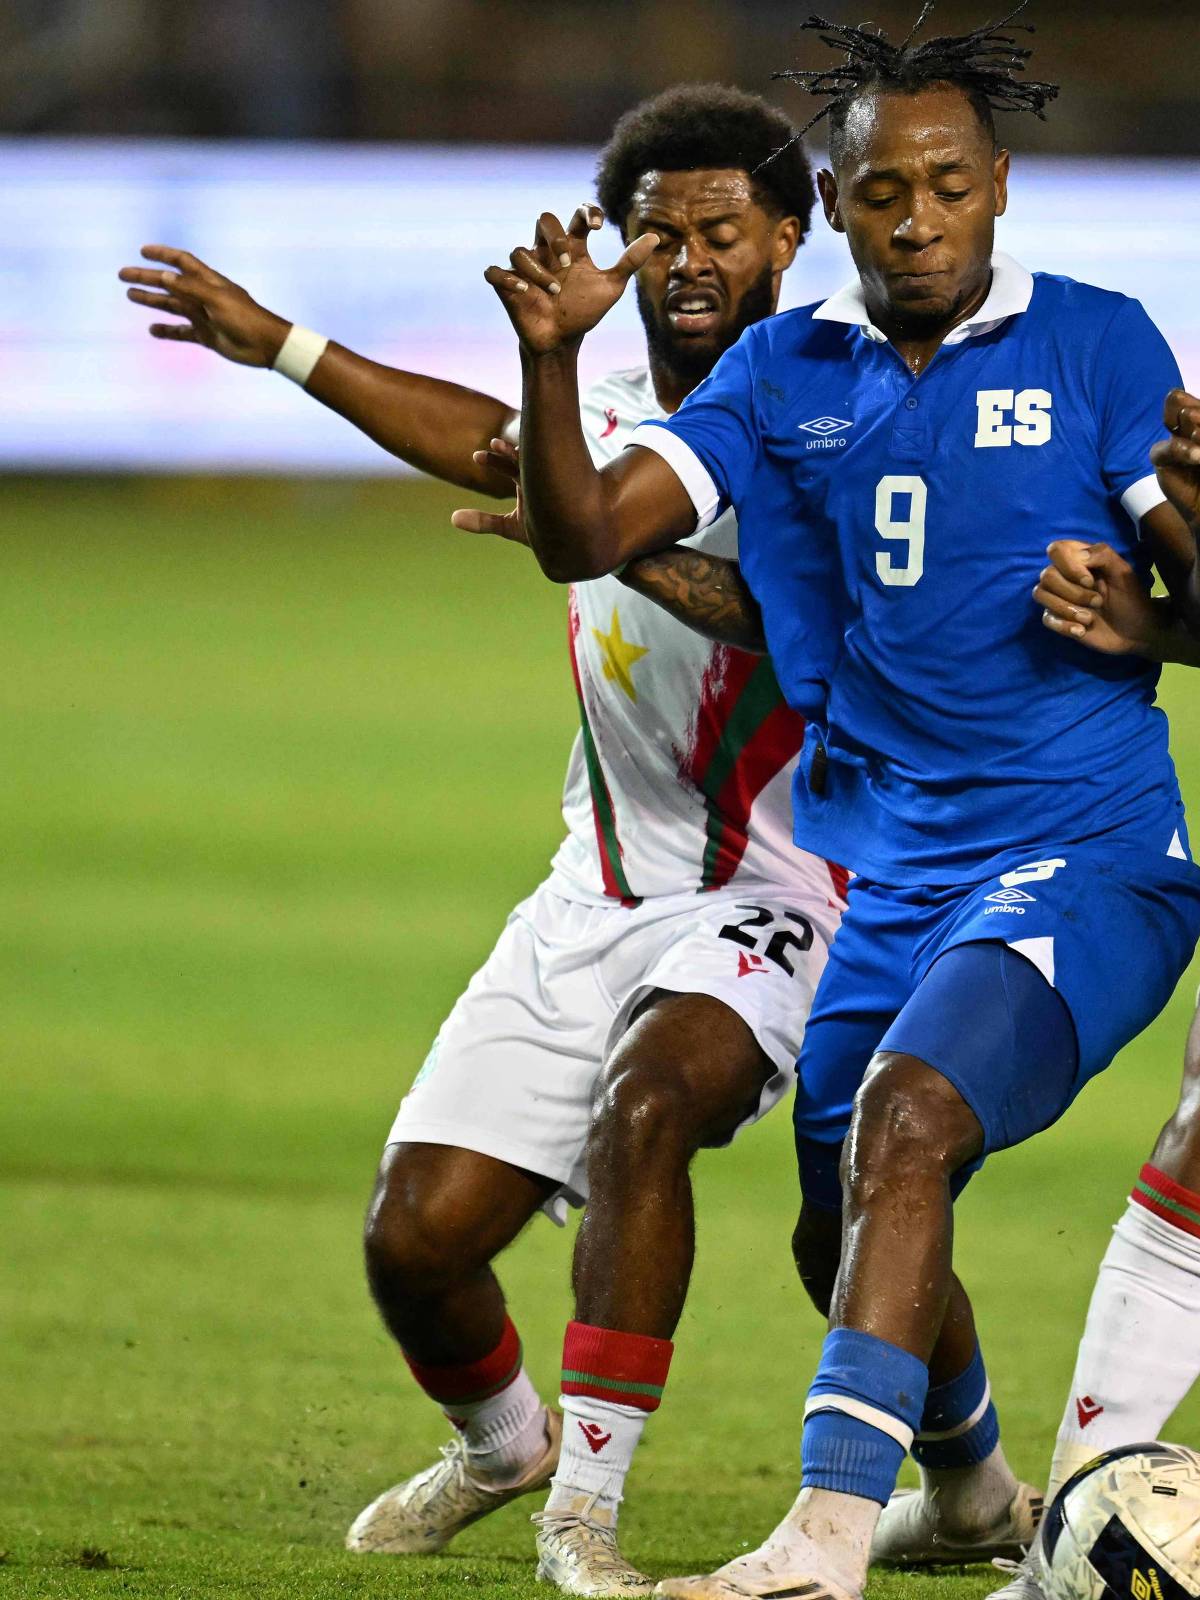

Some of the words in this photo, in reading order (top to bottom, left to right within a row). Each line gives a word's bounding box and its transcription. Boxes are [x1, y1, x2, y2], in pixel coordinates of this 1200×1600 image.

[806, 436, 847, 449] umbro
[974, 388, 1052, 448] ES
[874, 475, 928, 586] 9
[984, 904, 1026, 915] umbro
[717, 904, 814, 978] 22
